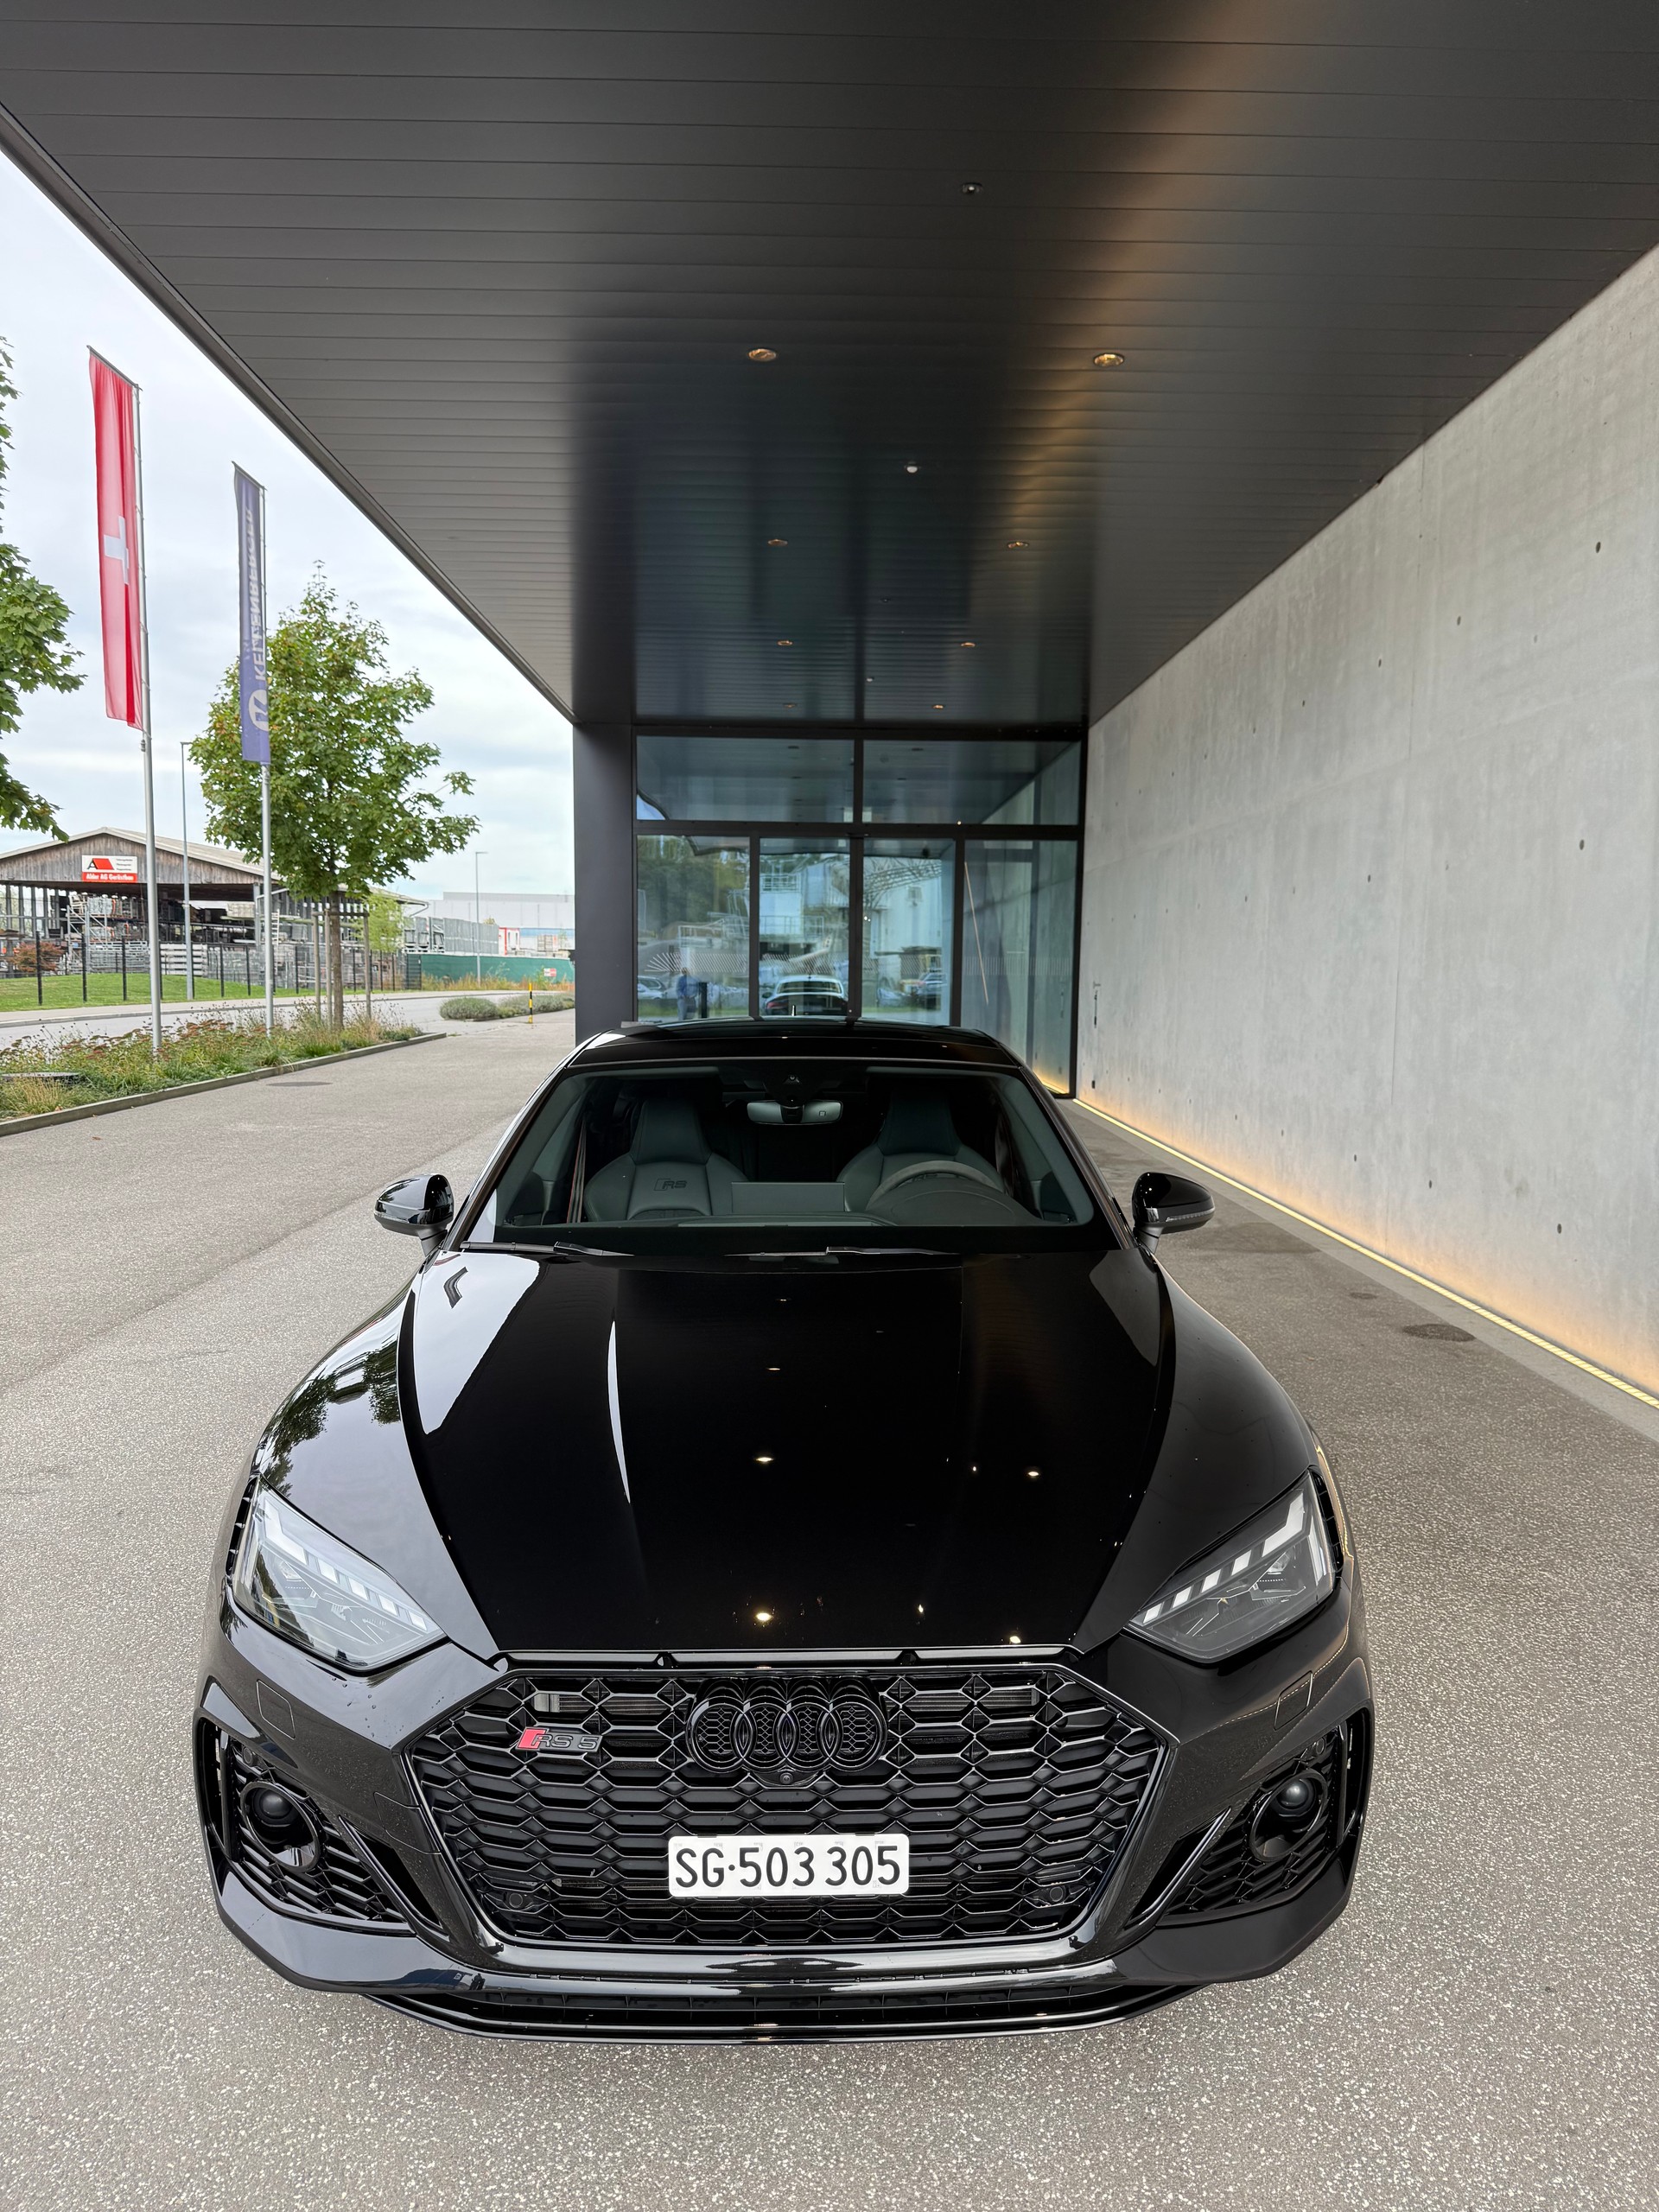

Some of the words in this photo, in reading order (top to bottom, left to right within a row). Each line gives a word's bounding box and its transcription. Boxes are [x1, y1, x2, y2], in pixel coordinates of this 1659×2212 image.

[661, 1179, 688, 1190] RS
[531, 1733, 574, 1748] RS
[577, 1735, 600, 1750] 5
[824, 1845, 900, 1886] 305
